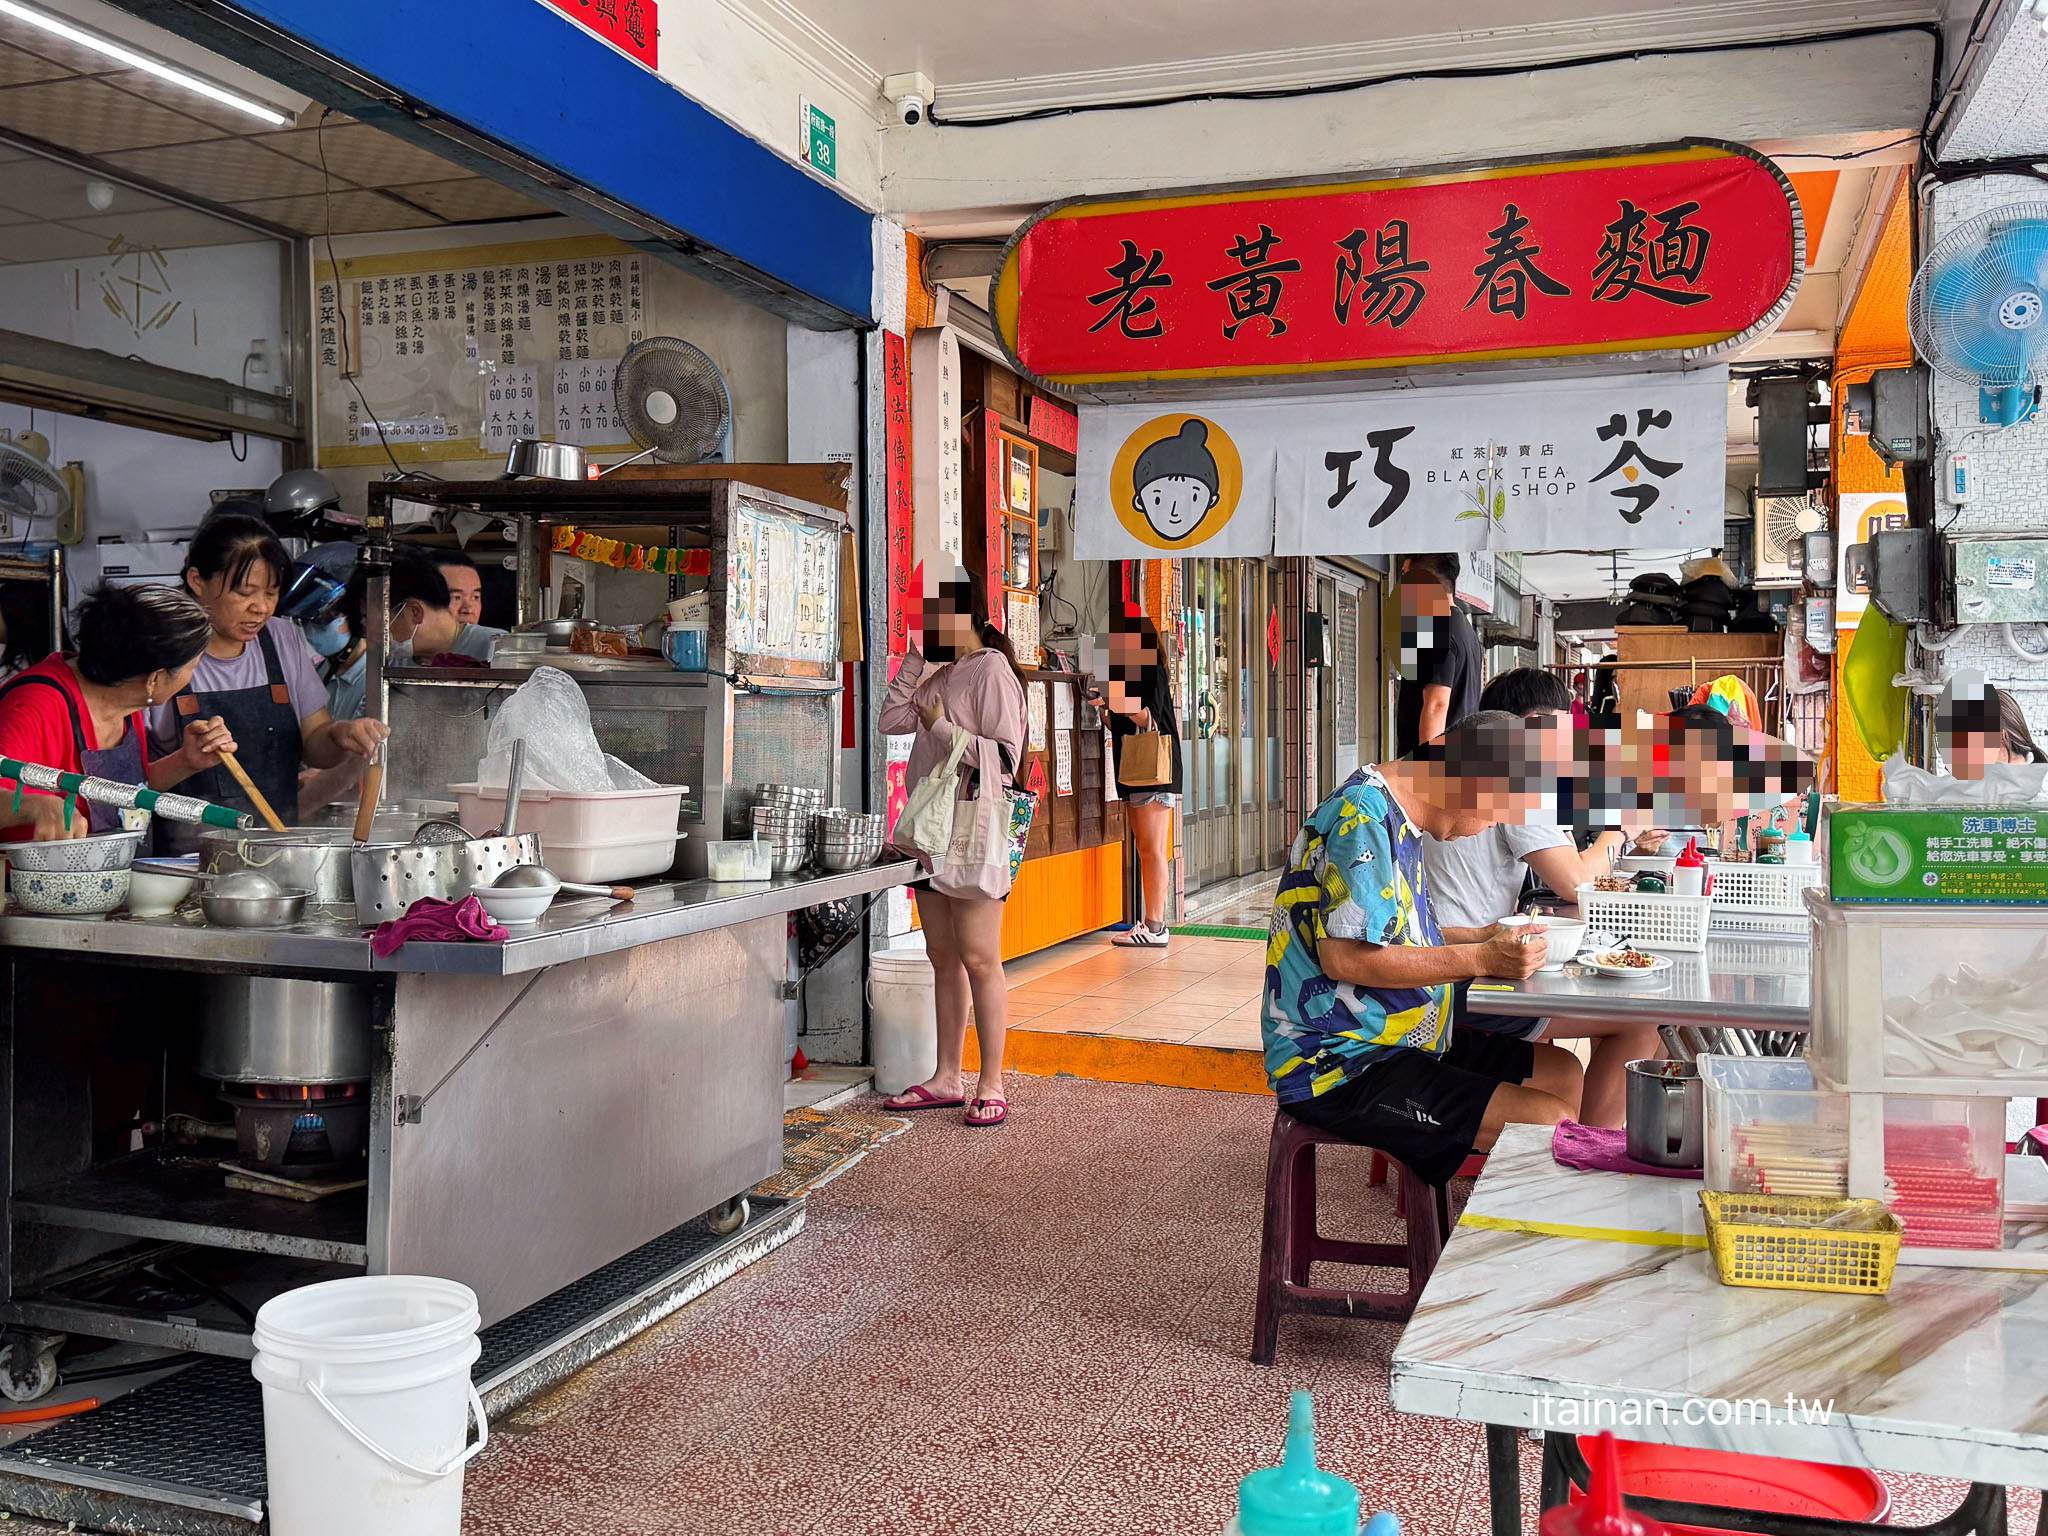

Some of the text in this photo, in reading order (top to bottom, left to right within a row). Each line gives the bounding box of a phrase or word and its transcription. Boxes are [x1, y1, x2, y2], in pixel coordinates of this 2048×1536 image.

[816, 139, 830, 165] 38
[462, 272, 478, 291] 湯
[1086, 199, 1713, 341] 老黃陽春麵
[426, 274, 440, 320] 蛋花湯
[443, 273, 456, 320] 蛋包湯
[535, 265, 553, 307] 湯麵
[591, 260, 606, 325] 沙茶乾麵
[361, 281, 374, 326] 餛飩湯
[377, 278, 390, 325] 貢丸湯
[631, 330, 642, 341] 60
[490, 375, 501, 400] 小 60
[505, 374, 517, 399] 小 60
[521, 373, 533, 398] 小 50
[558, 369, 569, 394] 小 60
[579, 367, 591, 392] 小 60
[595, 366, 607, 391] 小 60
[491, 411, 502, 437] 大 70
[506, 410, 518, 435] 大 70
[523, 409, 534, 435] 大 60
[559, 405, 570, 430] 大 70
[580, 403, 592, 429] 大 70
[597, 402, 608, 428] 大 70
[433, 424, 444, 434] 25
[448, 425, 459, 436] 25
[1450, 444, 1554, 460] 紅茶專賣店
[1324, 425, 1416, 528] 巧
[1427, 466, 1566, 483] BLACK TEA
[1511, 482, 1576, 497] SHOP
[1962, 817, 2037, 834] 洗車博士
